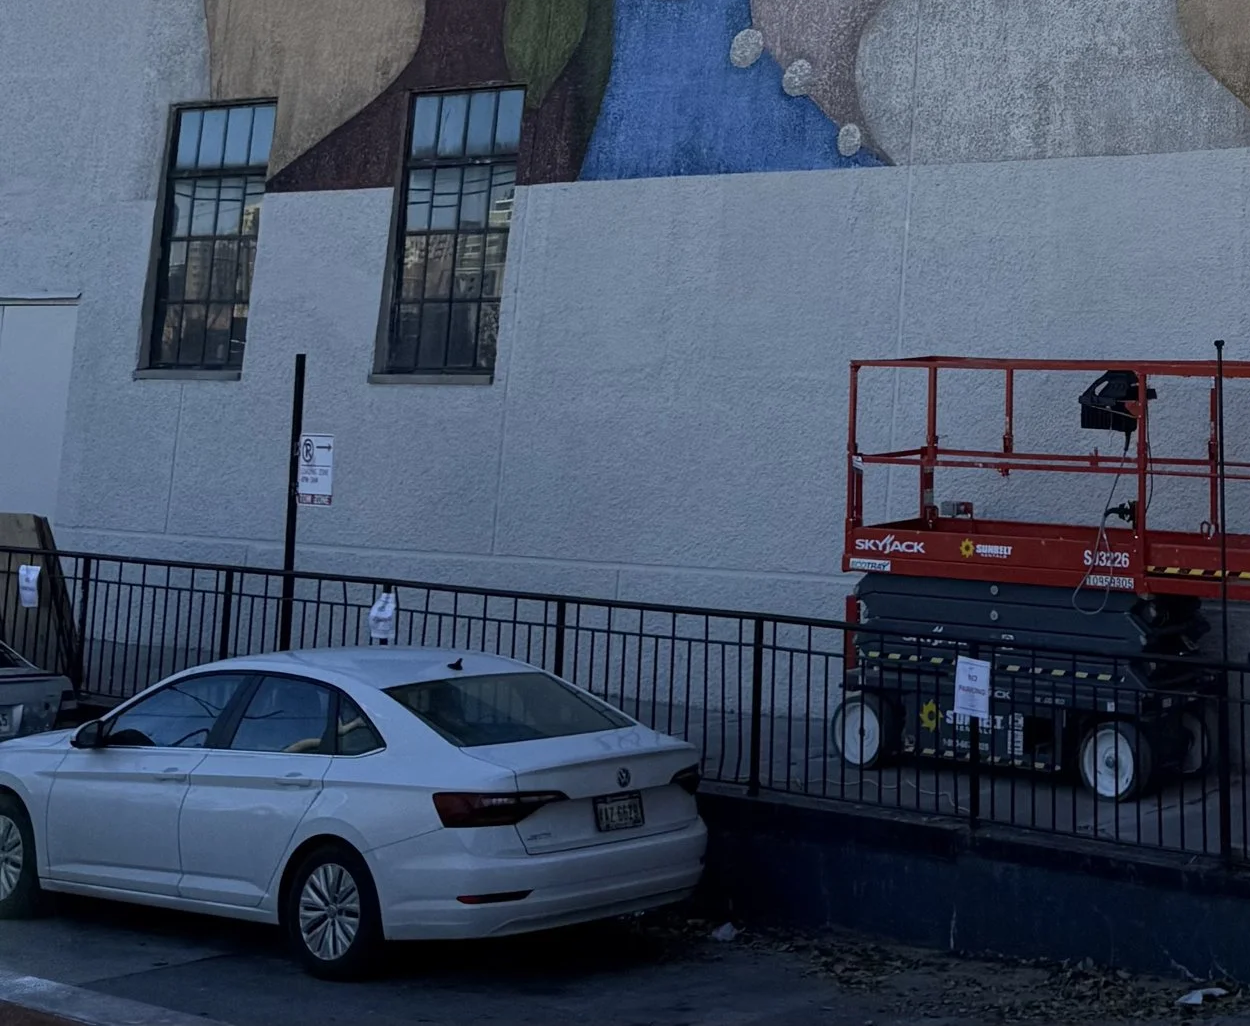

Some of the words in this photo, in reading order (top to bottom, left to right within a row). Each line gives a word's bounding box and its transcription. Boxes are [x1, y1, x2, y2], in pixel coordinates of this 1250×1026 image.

[855, 534, 926, 554] SKYJACK
[975, 544, 1013, 555] SUNBELT
[1083, 549, 1130, 568] SJ3226
